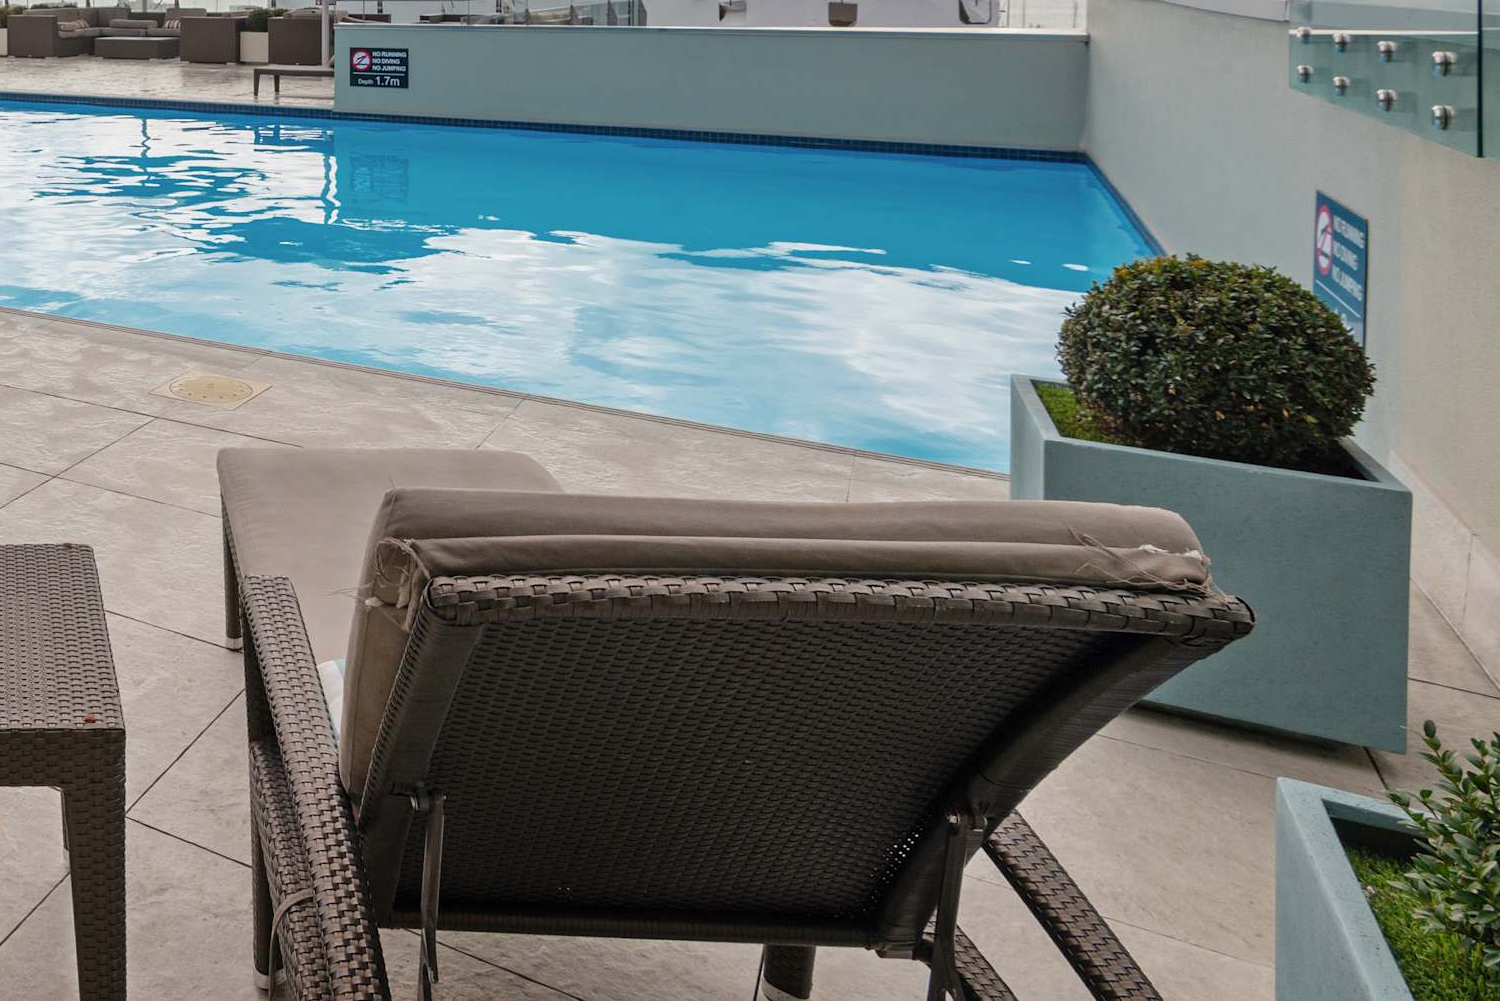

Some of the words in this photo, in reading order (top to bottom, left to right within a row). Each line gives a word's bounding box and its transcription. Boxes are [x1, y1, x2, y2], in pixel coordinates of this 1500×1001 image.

[375, 76, 400, 86] 1.7m
[1333, 215, 1341, 232] NO
[1332, 240, 1340, 257] NO
[1341, 245, 1358, 270] DIVING
[1332, 264, 1340, 282] NO
[1340, 270, 1362, 301] JUMPING
